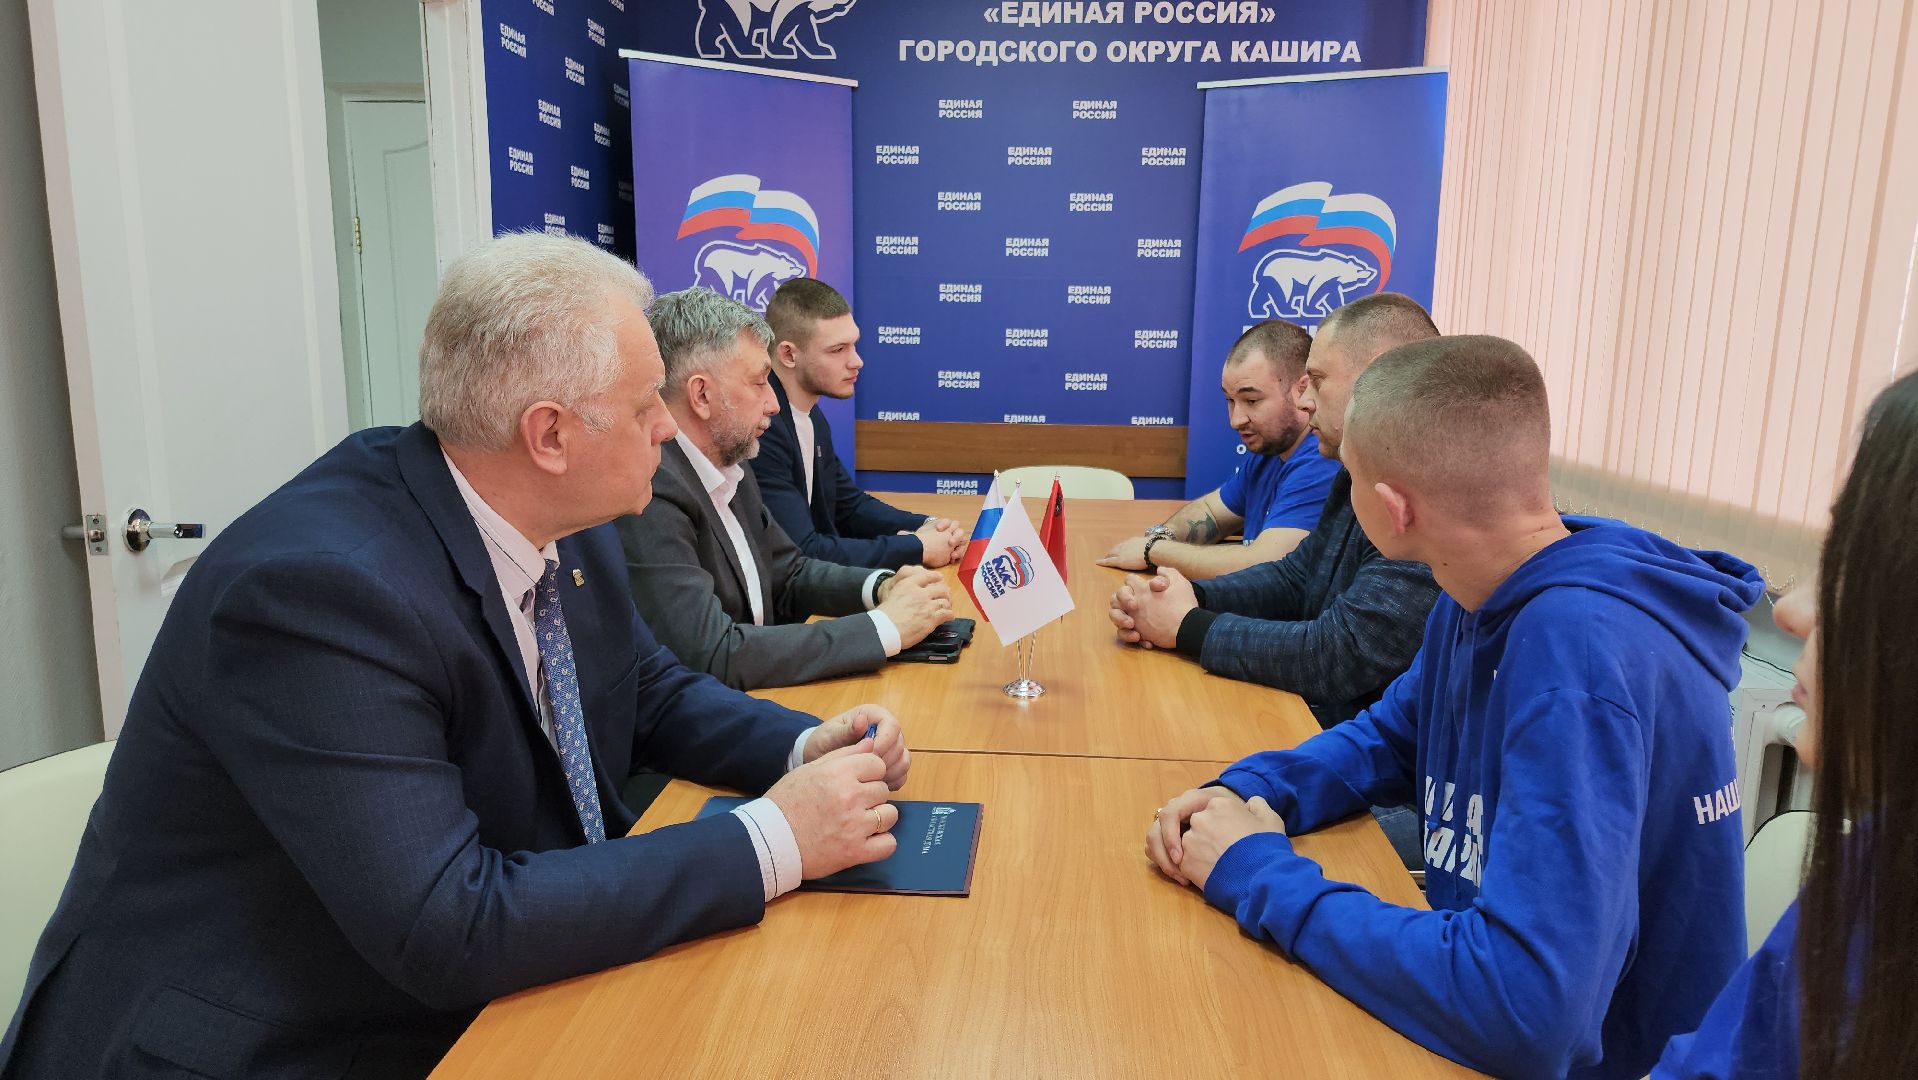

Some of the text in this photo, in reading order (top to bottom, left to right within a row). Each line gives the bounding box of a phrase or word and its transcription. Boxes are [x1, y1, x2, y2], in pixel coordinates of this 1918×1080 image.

[983, 0, 1276, 28] «ЕДИНАЯ РОССИЯ»
[500, 23, 526, 45] ЕДИНАЯ
[501, 37, 527, 58] РОССИЯ
[899, 39, 1362, 67] ГОРОДСКОГО ОКРУГА КАШИРА
[538, 99, 561, 118] ЕДИНАЯ
[938, 99, 983, 110] ЕДИНАЯ
[1072, 99, 1118, 111] ЕДИНАЯ
[938, 109, 983, 119] РОССИЯ
[1072, 110, 1118, 120] РОССИЯ
[539, 112, 562, 129] РОССИЯ
[508, 146, 534, 164] ЕДИНАЯ
[875, 144, 920, 155] ЕДИНАЯ
[1007, 146, 1053, 157] ЕДИНАЯ
[1141, 146, 1187, 157] ЕДИНАЯ
[875, 154, 920, 165] РОССИЯ
[1007, 156, 1053, 166] РОССИЯ
[1141, 156, 1187, 166] РОССИЯ
[509, 160, 534, 176] РОССИЯ
[937, 191, 982, 202] ЕДИНАЯ
[1069, 192, 1114, 203] ЕДИНАЯ
[937, 201, 982, 211] РОССИЯ
[1069, 202, 1114, 212] РОССИЯ
[875, 235, 919, 246] ЕДИНАЯ
[1005, 237, 1050, 248] ЕДИНАЯ
[1136, 238, 1182, 249] ЕДИНАЯ
[875, 245, 919, 256] РОССИЯ
[1005, 247, 1050, 257] РОССИЯ
[1136, 248, 1182, 258] РОССИЯ
[938, 283, 983, 294] ЕДИНАЯ
[1067, 285, 1112, 295] ЕДИНАЯ
[938, 293, 983, 303] РОССИЯ
[1067, 294, 1112, 305] РОССИЯ
[878, 326, 921, 336] ЕДИНАЯ
[1005, 328, 1049, 339] ЕДИНАЯ
[1134, 329, 1179, 340] ЕДИНАЯ
[878, 335, 921, 345] РОССИЯ
[1005, 338, 1049, 348] РОССИЯ
[1134, 339, 1179, 349] РОССИЯ
[937, 370, 981, 380] ЕДИНАЯ
[1064, 372, 1108, 383] ЕДИНАЯ
[937, 379, 981, 389] РОССИЯ
[1064, 382, 1108, 391] РОССИЯ
[877, 412, 920, 421] ЕДИНАЯ
[1003, 415, 1046, 424] ЕДИНАЯ
[1131, 417, 1174, 427] ЕДИНАЯ
[936, 480, 978, 489] ЕДИНАЯ
[985, 561, 1006, 596] ЕДИНАЯ
